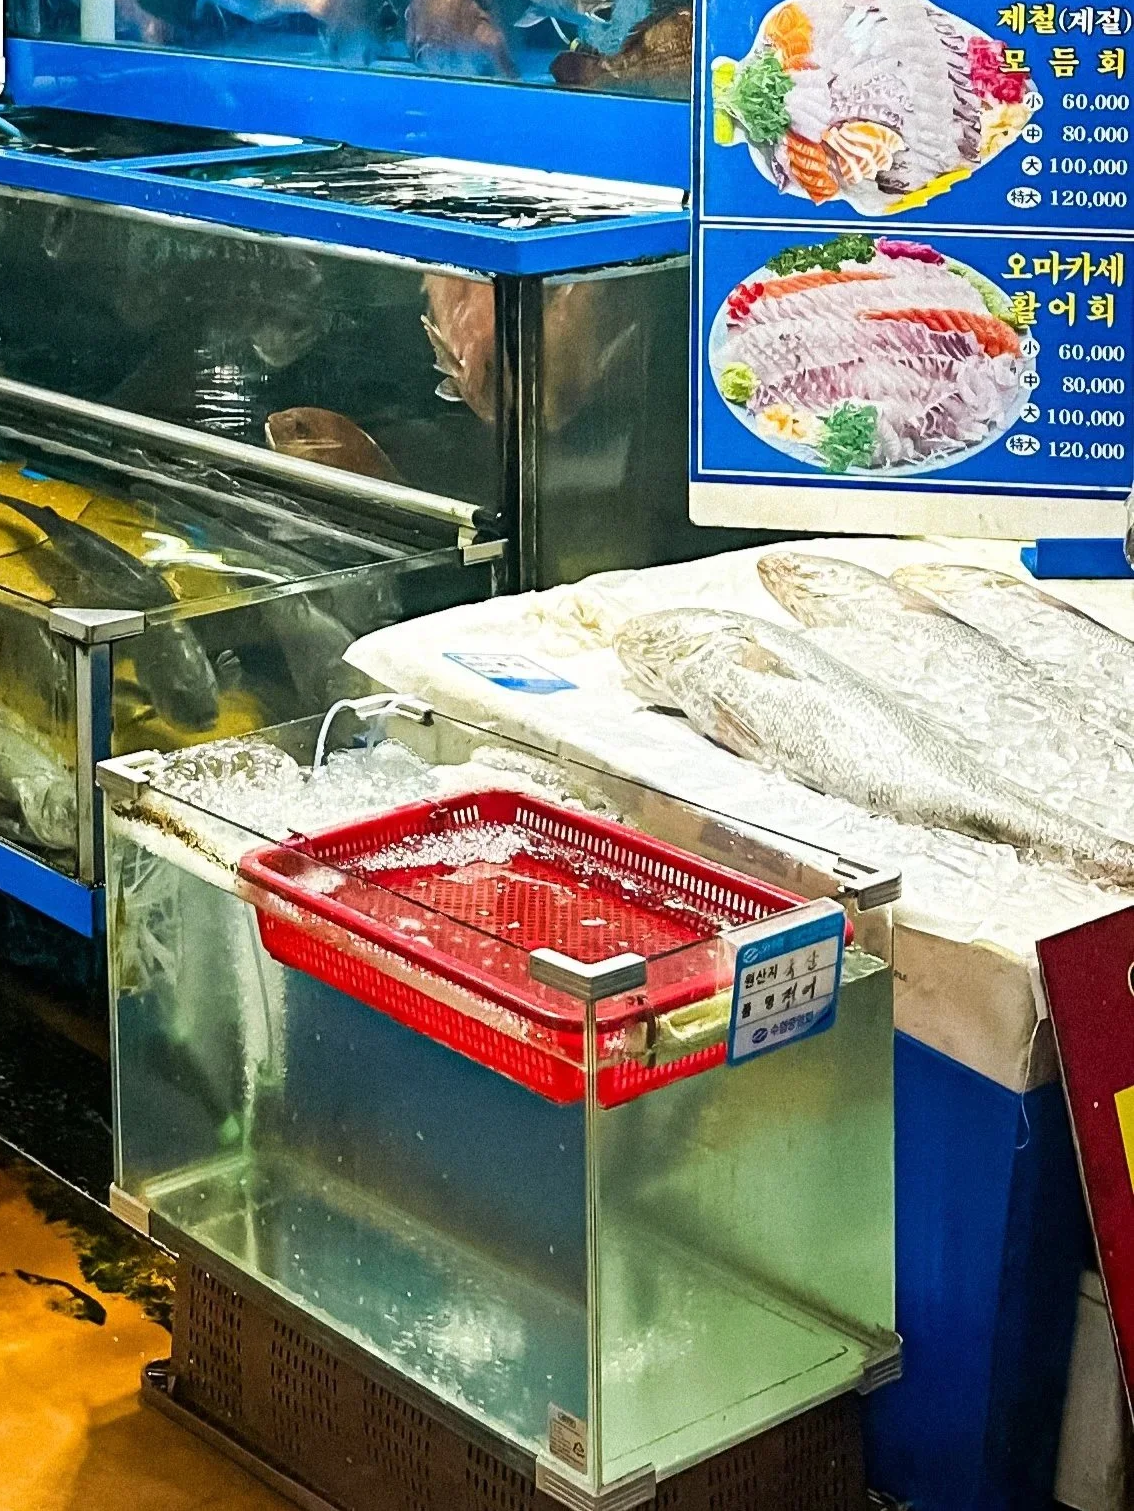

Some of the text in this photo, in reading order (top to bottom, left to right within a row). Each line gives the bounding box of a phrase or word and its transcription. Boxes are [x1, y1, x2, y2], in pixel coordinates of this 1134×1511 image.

[997, 3, 1132, 35] 제철(계절)
[1024, 93, 1129, 111] 小 60,000
[1025, 126, 1129, 143] 中 80,000
[1023, 157, 1128, 176] 大 100,000
[1050, 190, 1127, 208] 120,000
[1001, 251, 1124, 288] 오마카세
[1009, 291, 1115, 328] 활어회
[1021, 339, 1124, 362] 小 60,000
[1022, 372, 1124, 394] 中 80,000
[1021, 404, 1124, 427] 大 100,000
[1049, 442, 1124, 460] 120,000
[744, 963, 778, 989] 원산지
